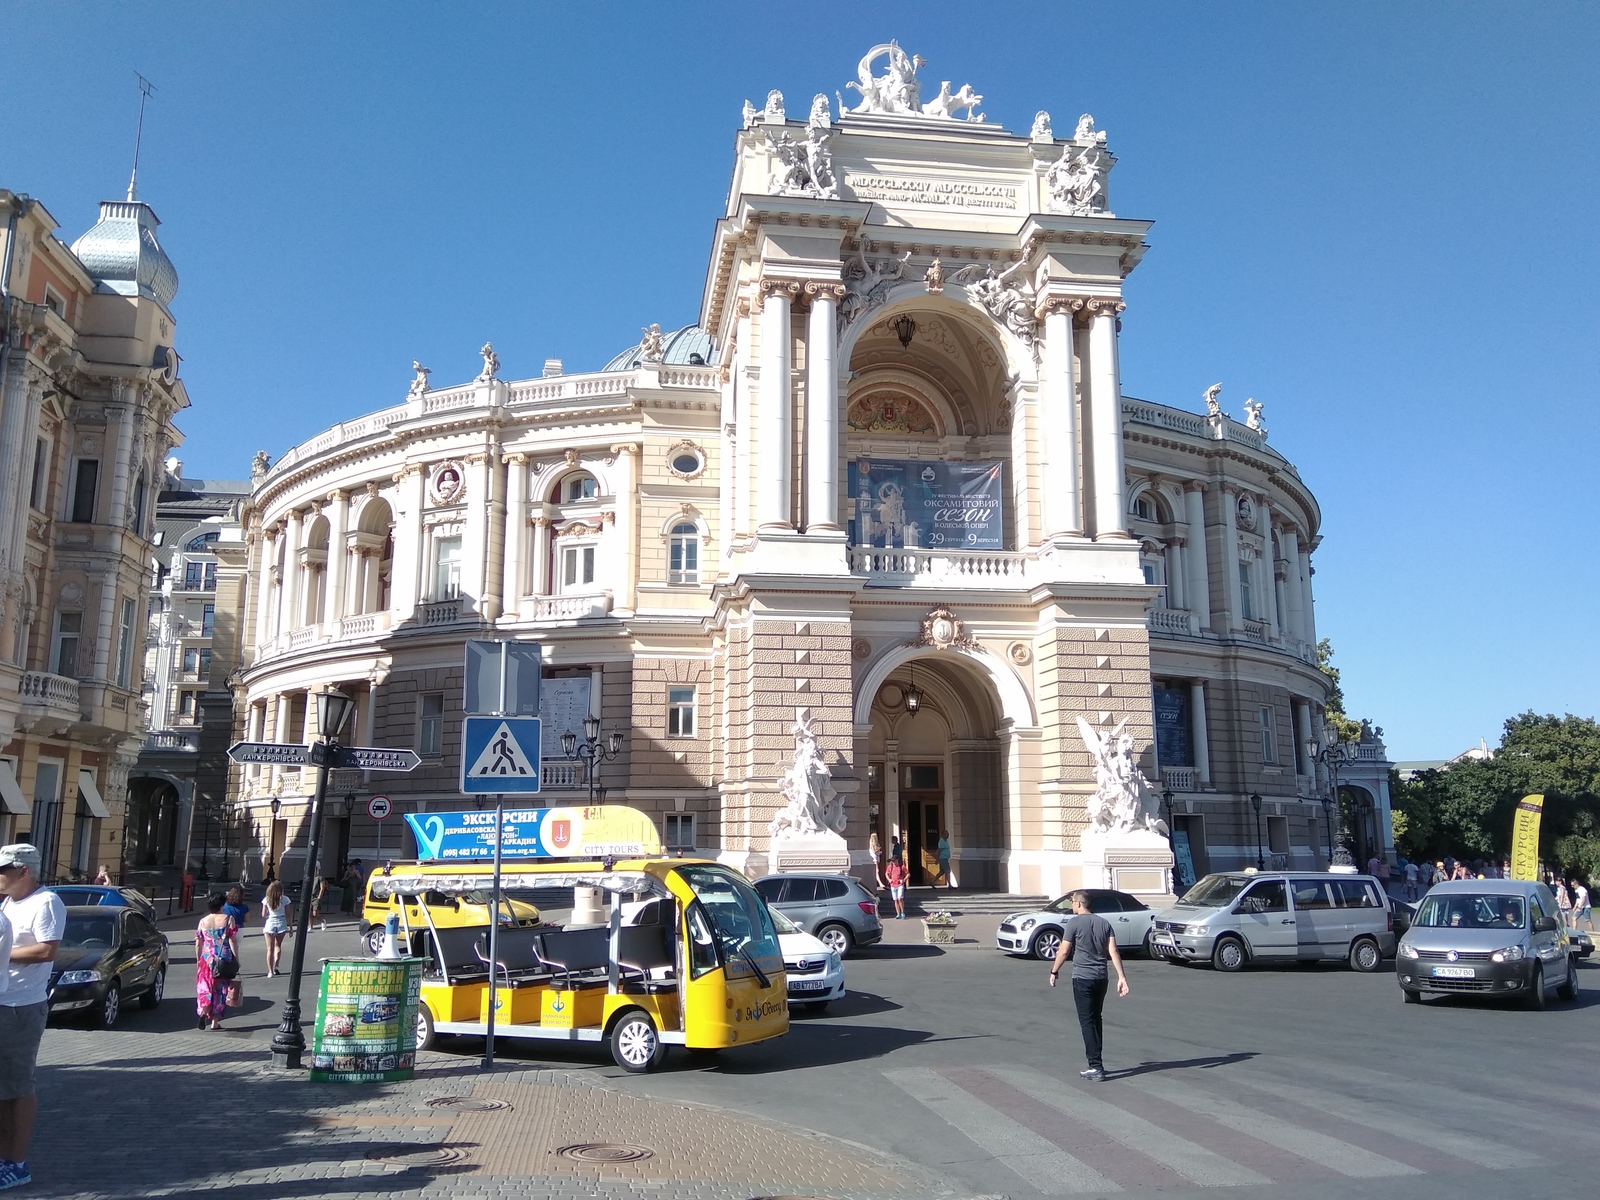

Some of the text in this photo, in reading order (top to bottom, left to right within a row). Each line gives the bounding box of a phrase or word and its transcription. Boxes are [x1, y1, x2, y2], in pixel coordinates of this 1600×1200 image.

[924, 499, 999, 508] ОКСАМИТОВИЙ
[928, 532, 944, 544] 29
[968, 533, 977, 545] 9
[253, 746, 297, 755] ВУЛИЦЯ
[242, 754, 305, 762] ЛАНЖЕРОНІВСЬКА
[356, 752, 398, 760] ВУЛИЦЯ
[584, 845, 639, 854] CITY TOURS
[328, 970, 404, 984] ЭКСКУРСИИ
[328, 985, 336, 993] НА
[746, 1007, 752, 1020] Я
[365, 1044, 397, 1053] 10.00-21.00
